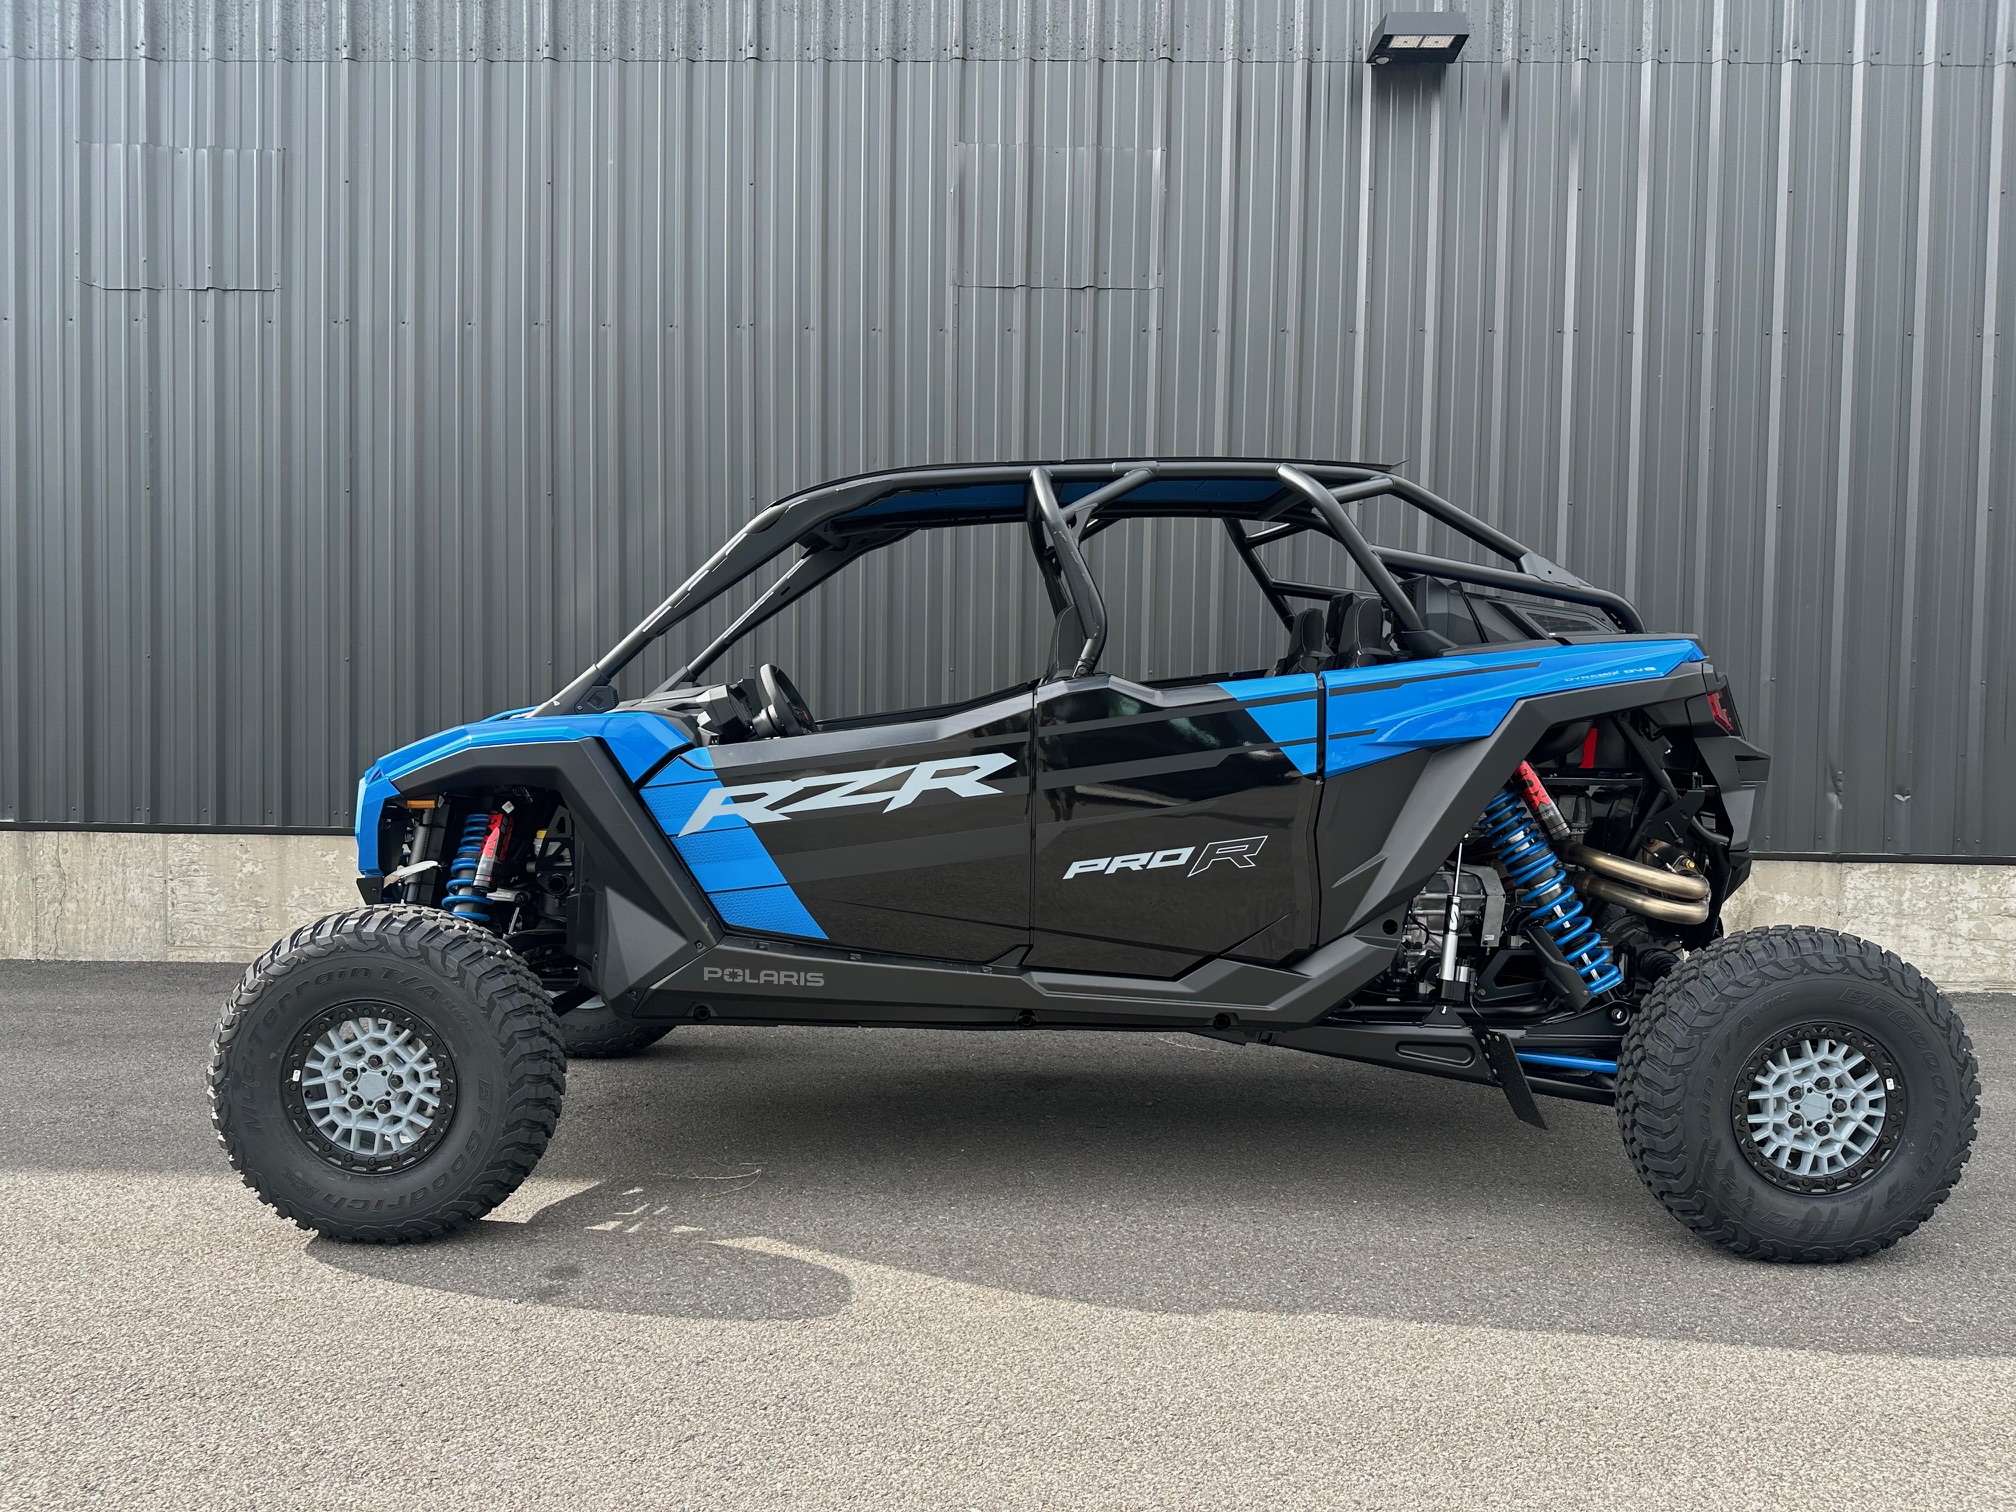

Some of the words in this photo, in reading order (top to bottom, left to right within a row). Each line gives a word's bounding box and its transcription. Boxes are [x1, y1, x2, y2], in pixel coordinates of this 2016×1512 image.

[677, 752, 1017, 838] RZR
[1062, 846, 1196, 880] PRO
[1187, 835, 1268, 878] R
[703, 966, 825, 987] POLARIS
[1838, 987, 1949, 1178] BFGoodrich
[322, 1078, 494, 1214] BFGoodrich
